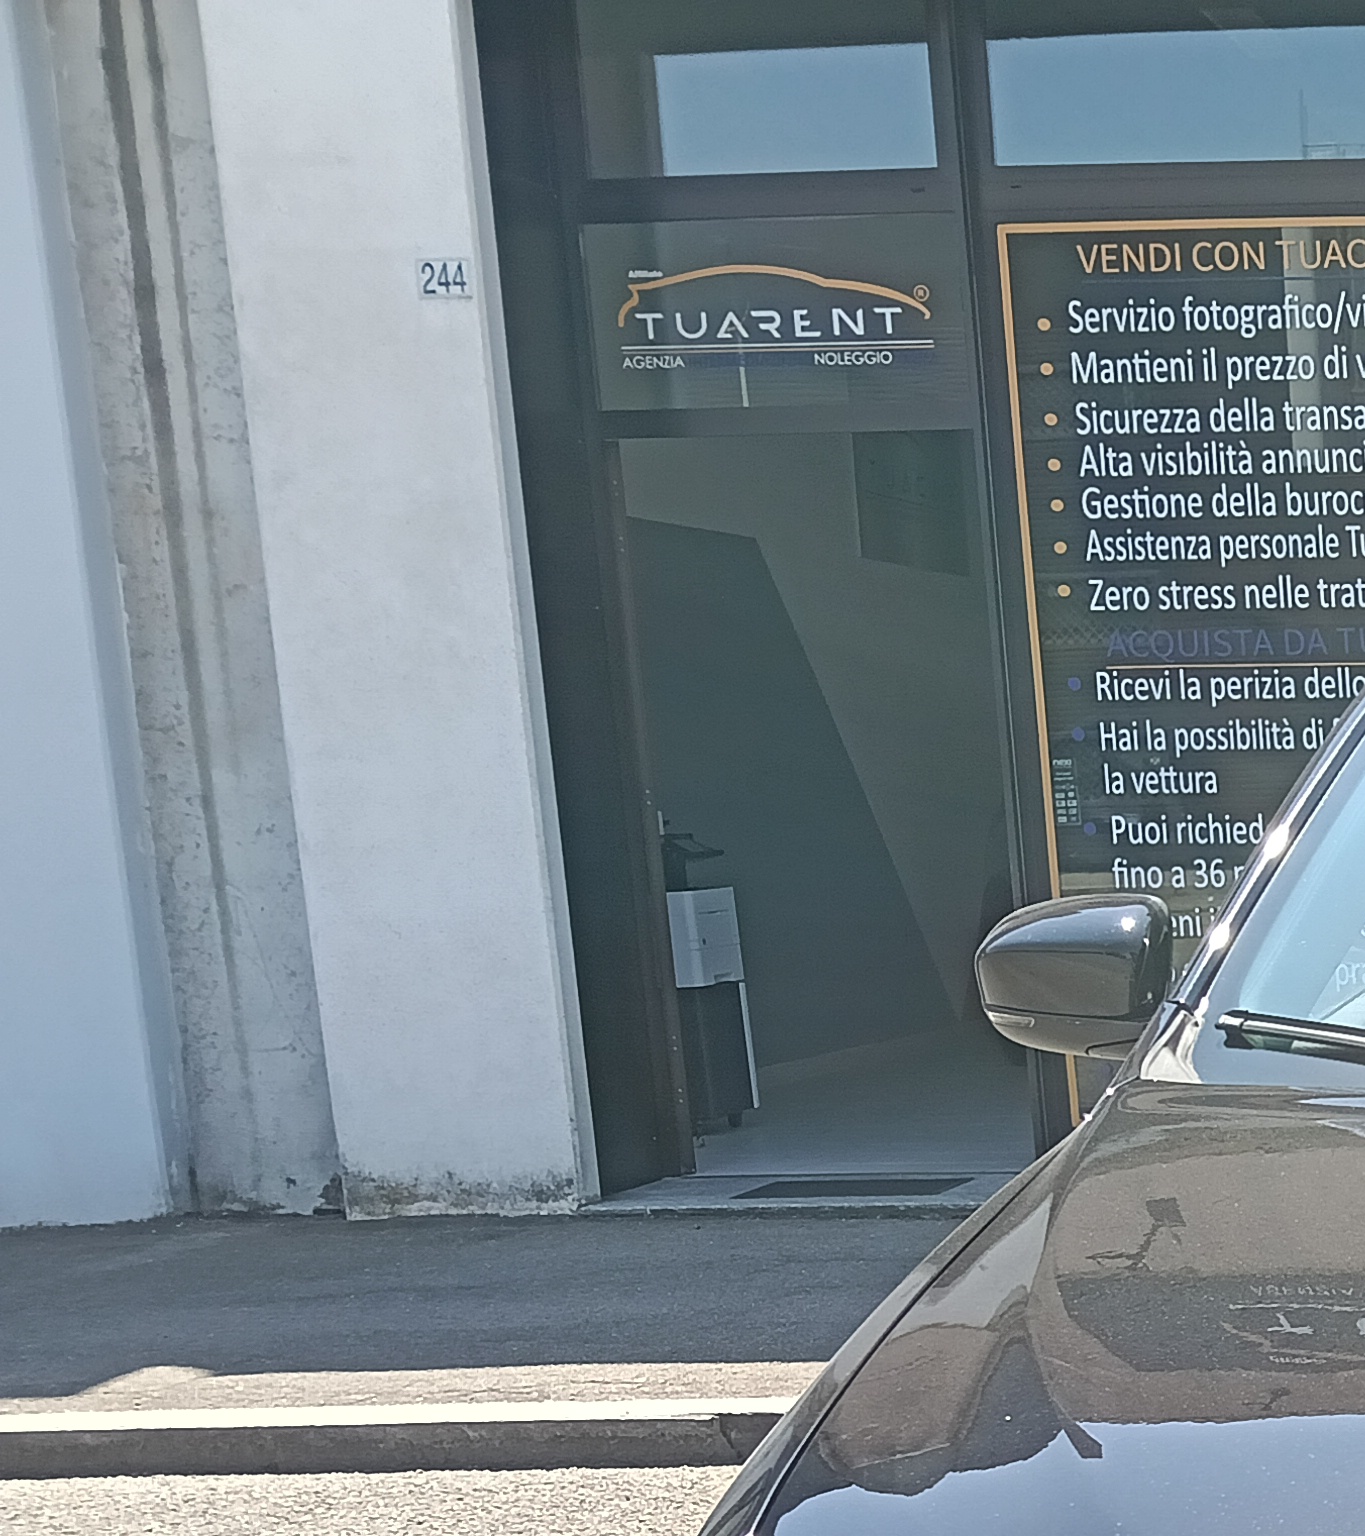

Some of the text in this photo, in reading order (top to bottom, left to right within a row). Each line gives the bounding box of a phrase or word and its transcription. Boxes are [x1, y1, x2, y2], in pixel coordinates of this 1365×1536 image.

[1076, 242, 1182, 274] VENDI
[1191, 240, 1265, 271] CON
[421, 262, 467, 294] 244
[635, 307, 903, 340] TUARENT
[1068, 299, 1175, 334] Servizio
[622, 351, 893, 370] AGENZIA NOLEGGIO
[1071, 349, 1194, 384] Mantieni
[1202, 346, 1217, 382] il
[1226, 354, 1315, 390] prezzo
[1323, 344, 1348, 380] di
[1075, 402, 1201, 436] Sicurezza
[1209, 397, 1275, 432] della
[1080, 442, 1133, 477] Alta
[1141, 440, 1253, 476] visibilità
[1081, 486, 1203, 519] Gestione
[1211, 482, 1277, 516] della
[1086, 528, 1211, 562] Assistenza
[1219, 523, 1340, 568] personale
[1088, 579, 1150, 611] Zero
[1158, 581, 1236, 609] stress
[1244, 574, 1310, 608] nelle
[1107, 629, 1275, 662] ACQUISTA
[1284, 629, 1328, 657] DA
[1096, 671, 1171, 701] Ricevi
[1179, 669, 1201, 700] la
[1210, 669, 1296, 707] perizia
[1100, 720, 1138, 752] Hai
[1145, 719, 1166, 751] la
[1174, 718, 1295, 757] possibilità
[1103, 763, 1218, 795] la vettura
[1111, 815, 1168, 845] Puoi
[1112, 858, 1163, 888] fino
[1171, 867, 1185, 888] a
[1193, 859, 1226, 888] 36
